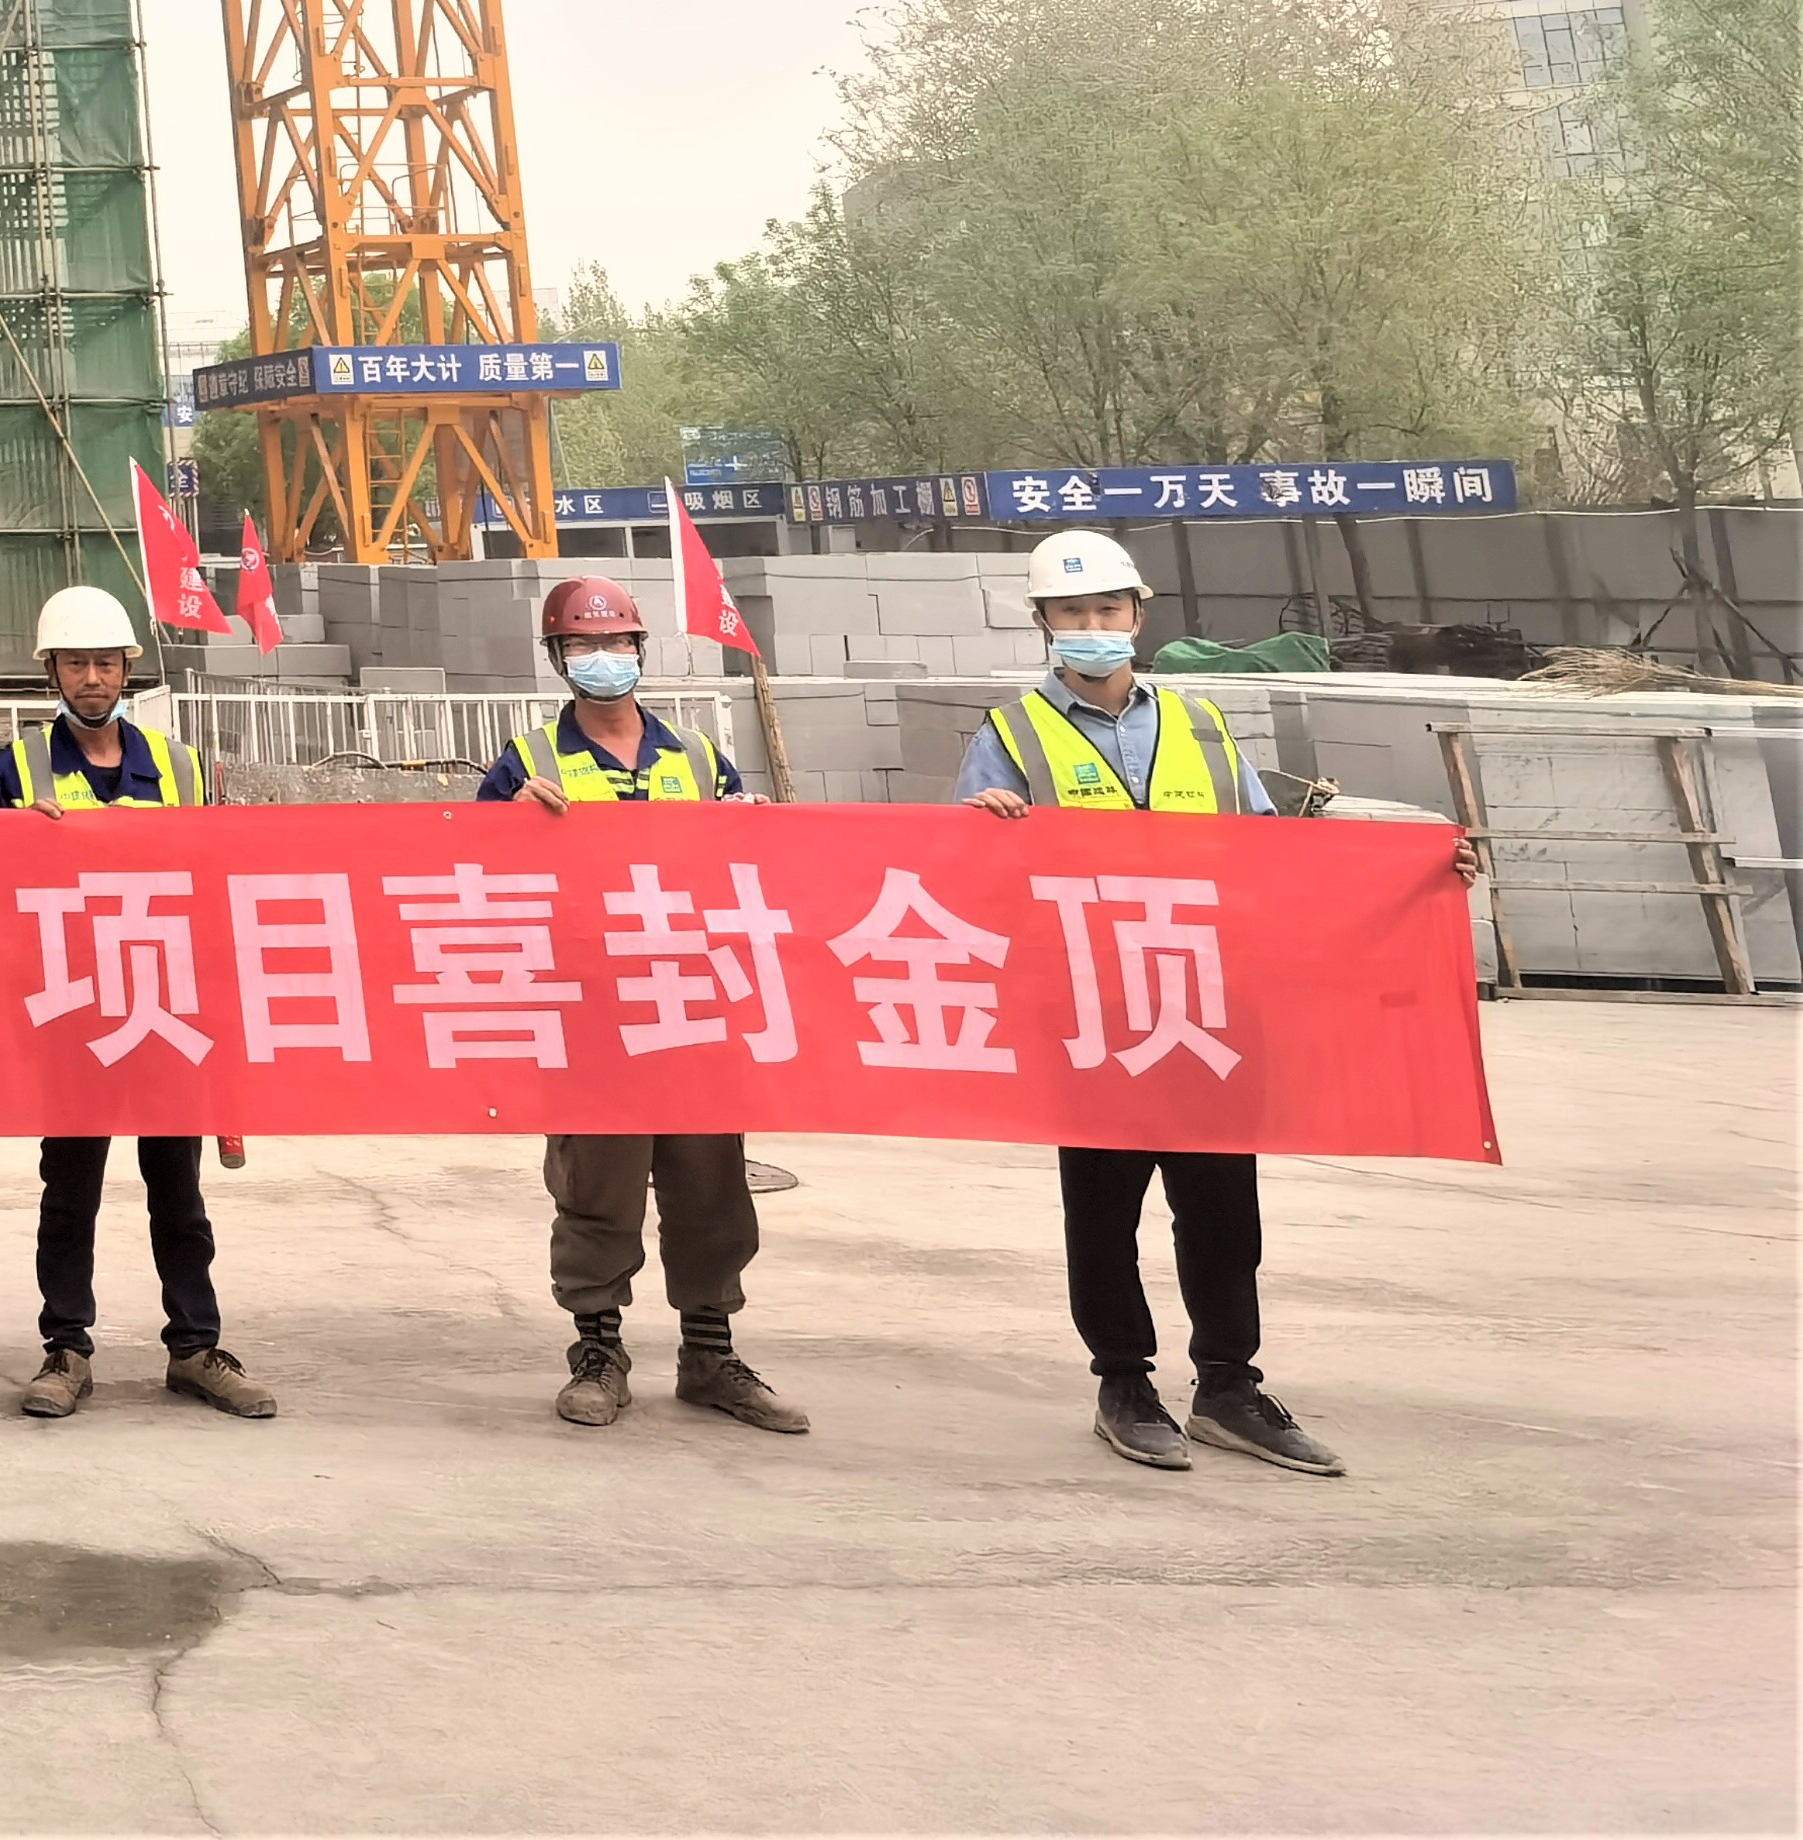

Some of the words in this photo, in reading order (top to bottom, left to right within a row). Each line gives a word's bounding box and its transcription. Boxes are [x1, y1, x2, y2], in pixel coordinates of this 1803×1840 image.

[359, 353, 461, 384] 百年大计
[478, 351, 580, 382] 质量第一
[684, 489, 763, 512] 吸烟区
[1011, 473, 1239, 514] 安全一万天
[1259, 466, 1494, 510] 事故一瞬间
